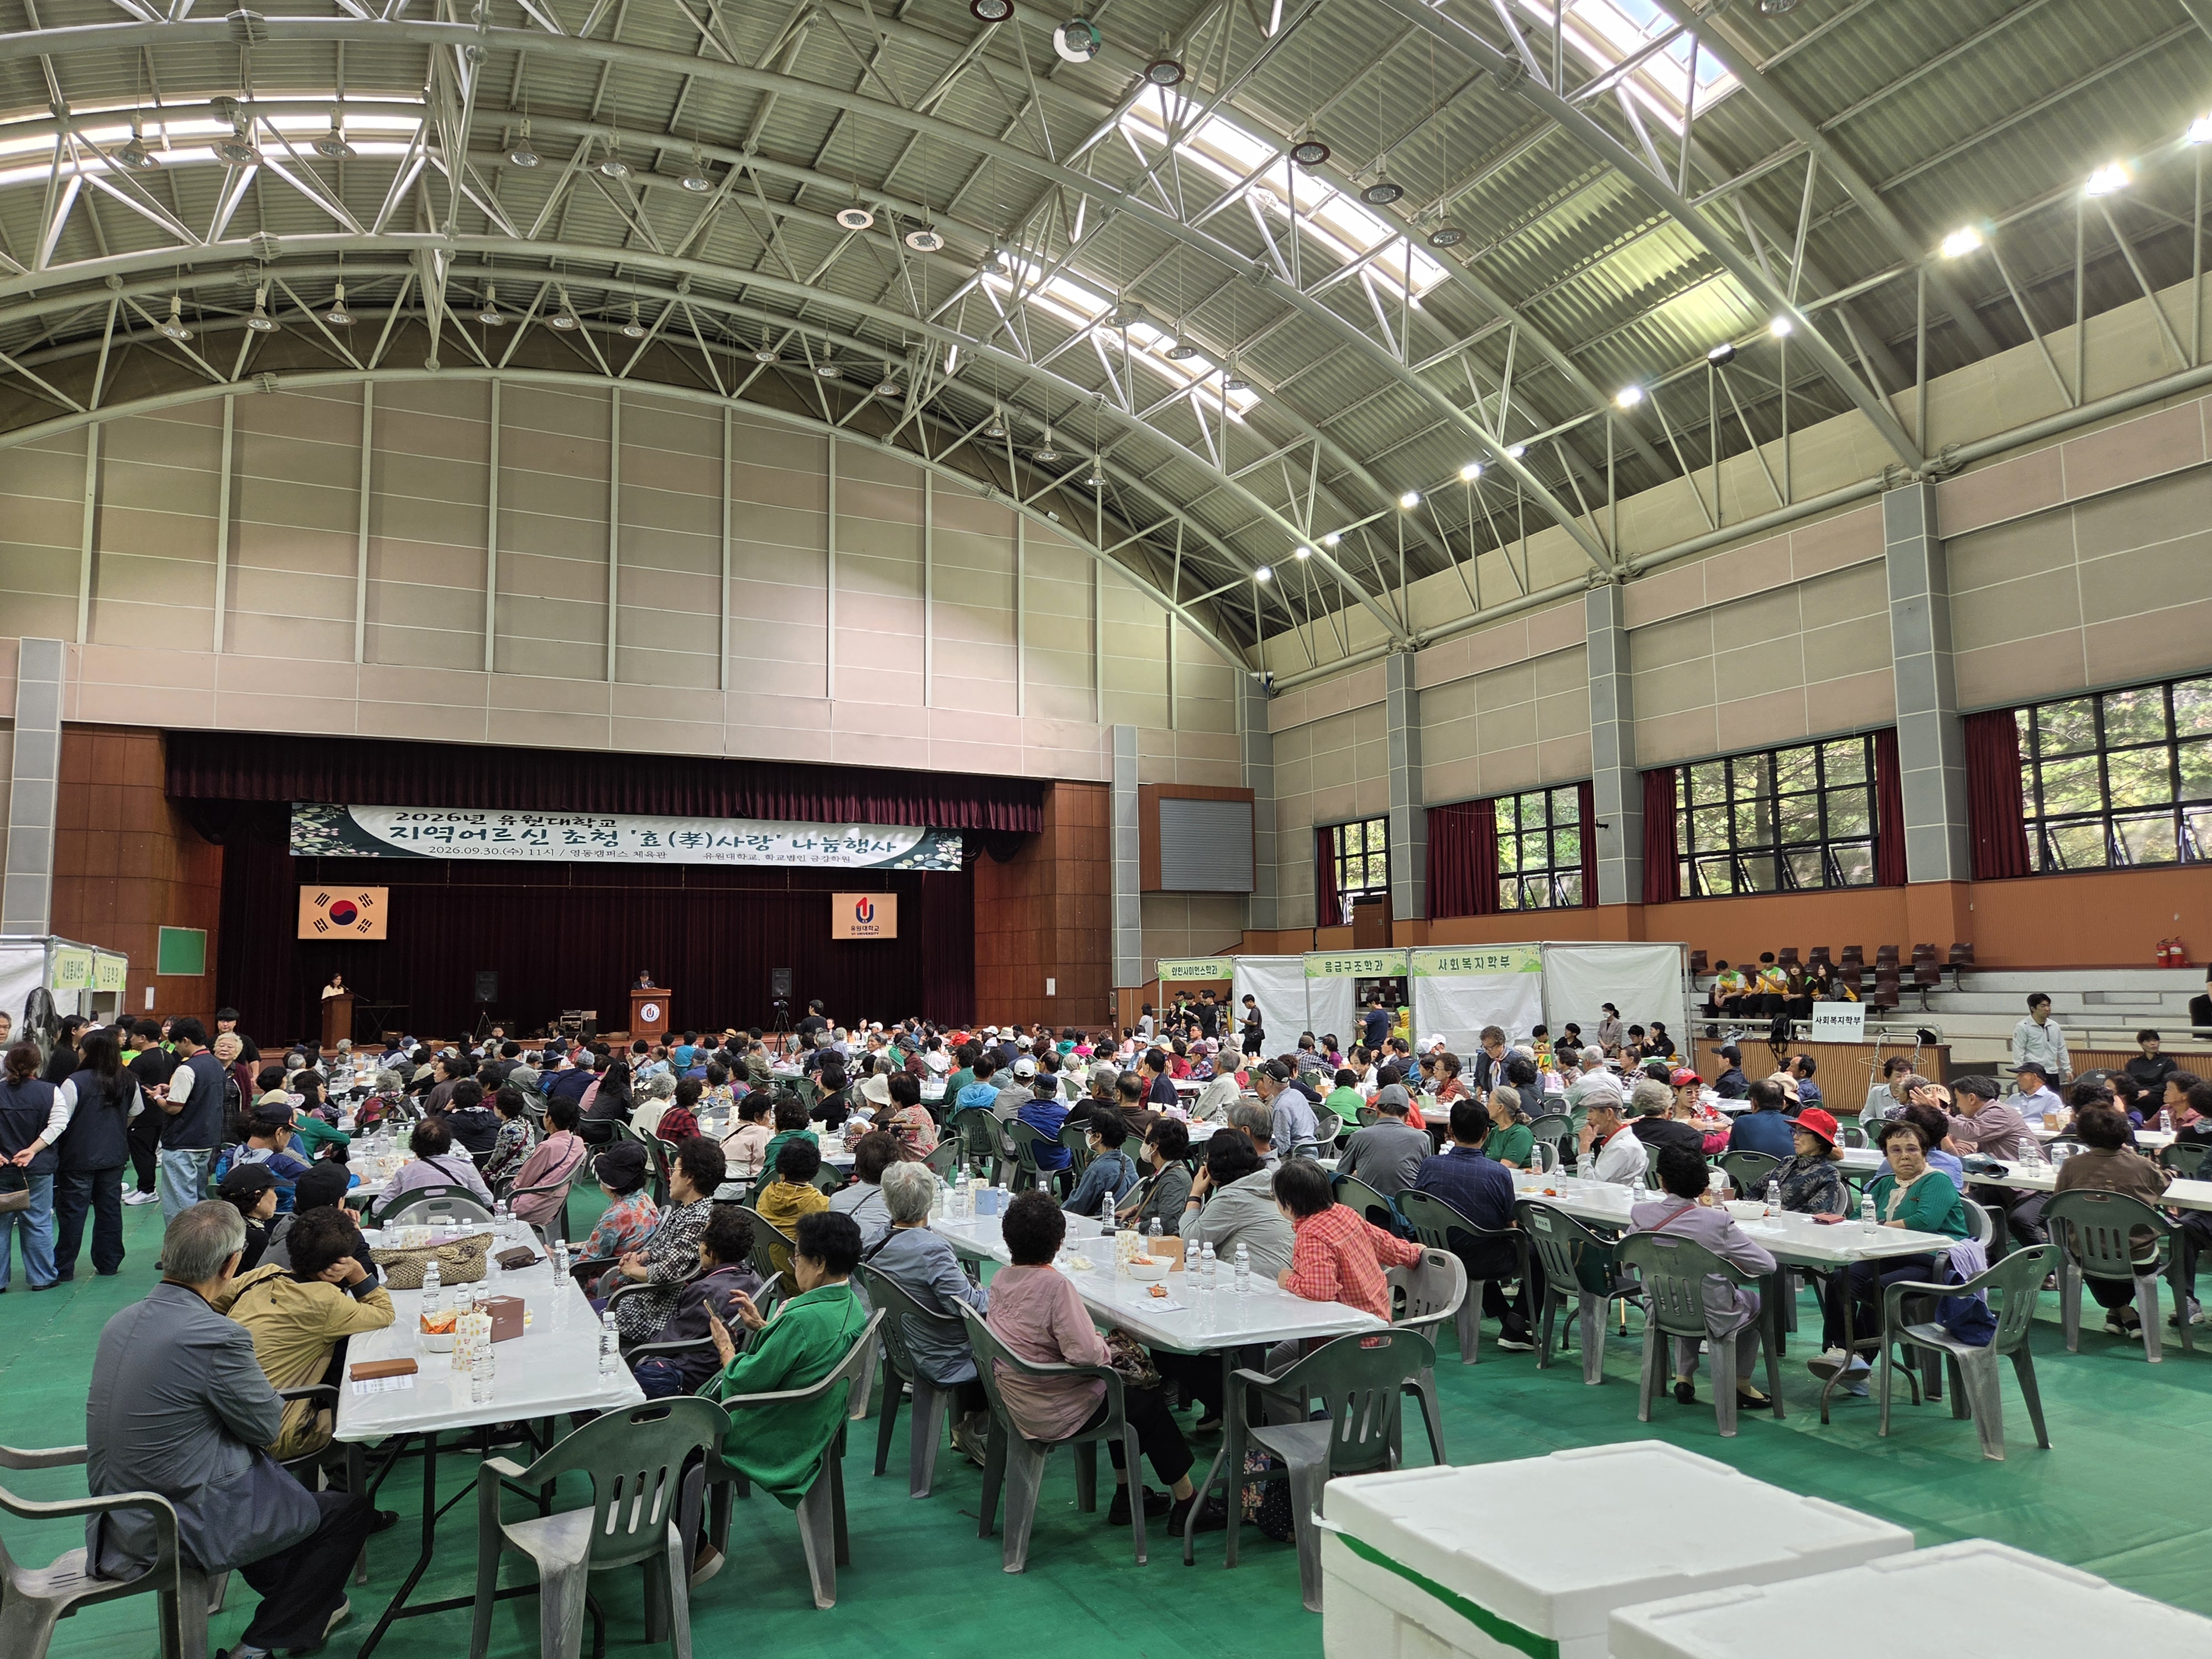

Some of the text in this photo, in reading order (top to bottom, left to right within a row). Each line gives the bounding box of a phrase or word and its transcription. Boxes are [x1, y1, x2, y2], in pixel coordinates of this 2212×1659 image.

[395, 812, 617, 828] 2026년 유원대학교
[389, 826, 549, 846] 지역어르신
[562, 828, 619, 847] 초청
[792, 836, 897, 854] 나눔행사
[429, 846, 524, 856] 2026.09.30.(수)
[529, 848, 554, 857] 11시
[570, 849, 629, 858] 영동캠퍼스
[632, 851, 667, 859] 체육관
[764, 854, 806, 862] 학교법인
[810, 855, 851, 863] 금강학원
[1324, 959, 1384, 973] 응급구조학과
[1438, 955, 1510, 971] 사회복지학부
[1171, 964, 1218, 976] 와인사이언스학과
[1815, 1016, 1861, 1025] 사회복지학부
